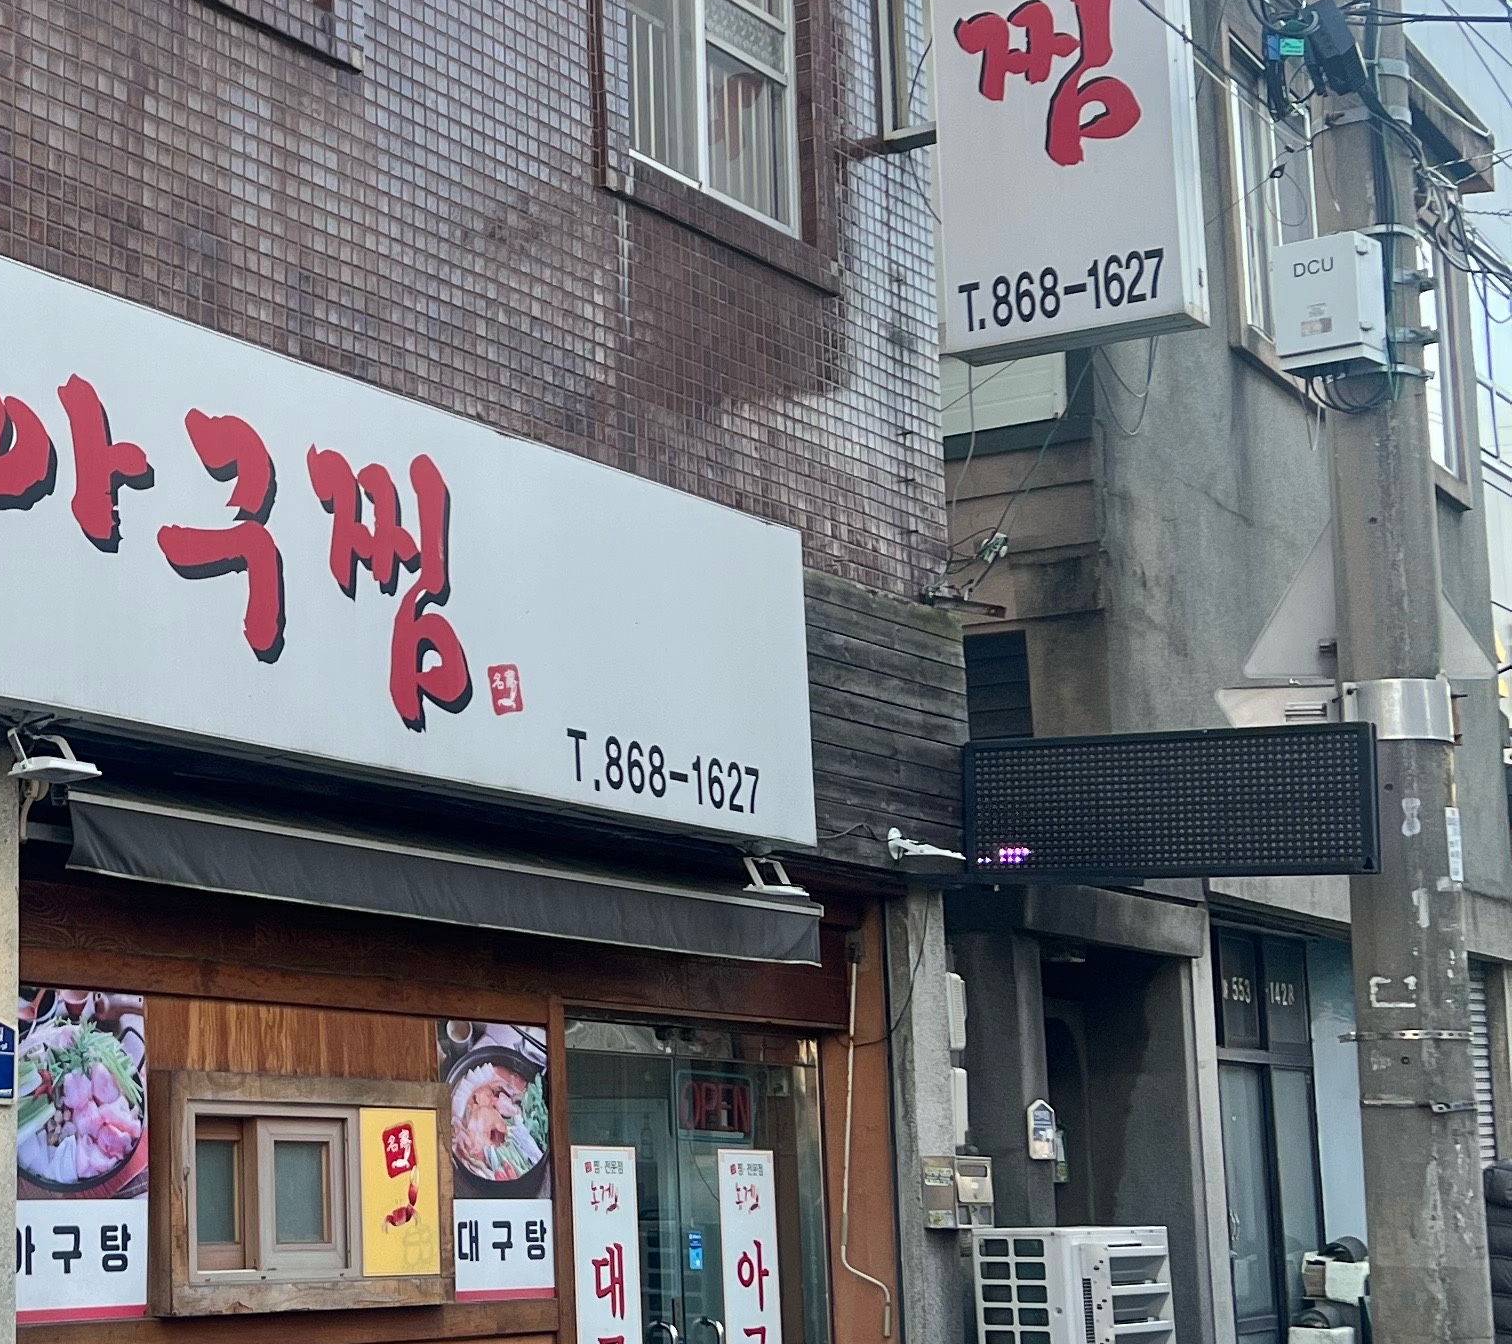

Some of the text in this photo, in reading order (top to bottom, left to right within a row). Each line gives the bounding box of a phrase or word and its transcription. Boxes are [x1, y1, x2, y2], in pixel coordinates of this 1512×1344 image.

[958, 247, 1164, 332] T.868-1627
[1293, 256, 1334, 278] DCU
[567, 728, 759, 814] T.868-1627
[679, 1080, 751, 1135] OPEN
[457, 1219, 547, 1262] 대구탕
